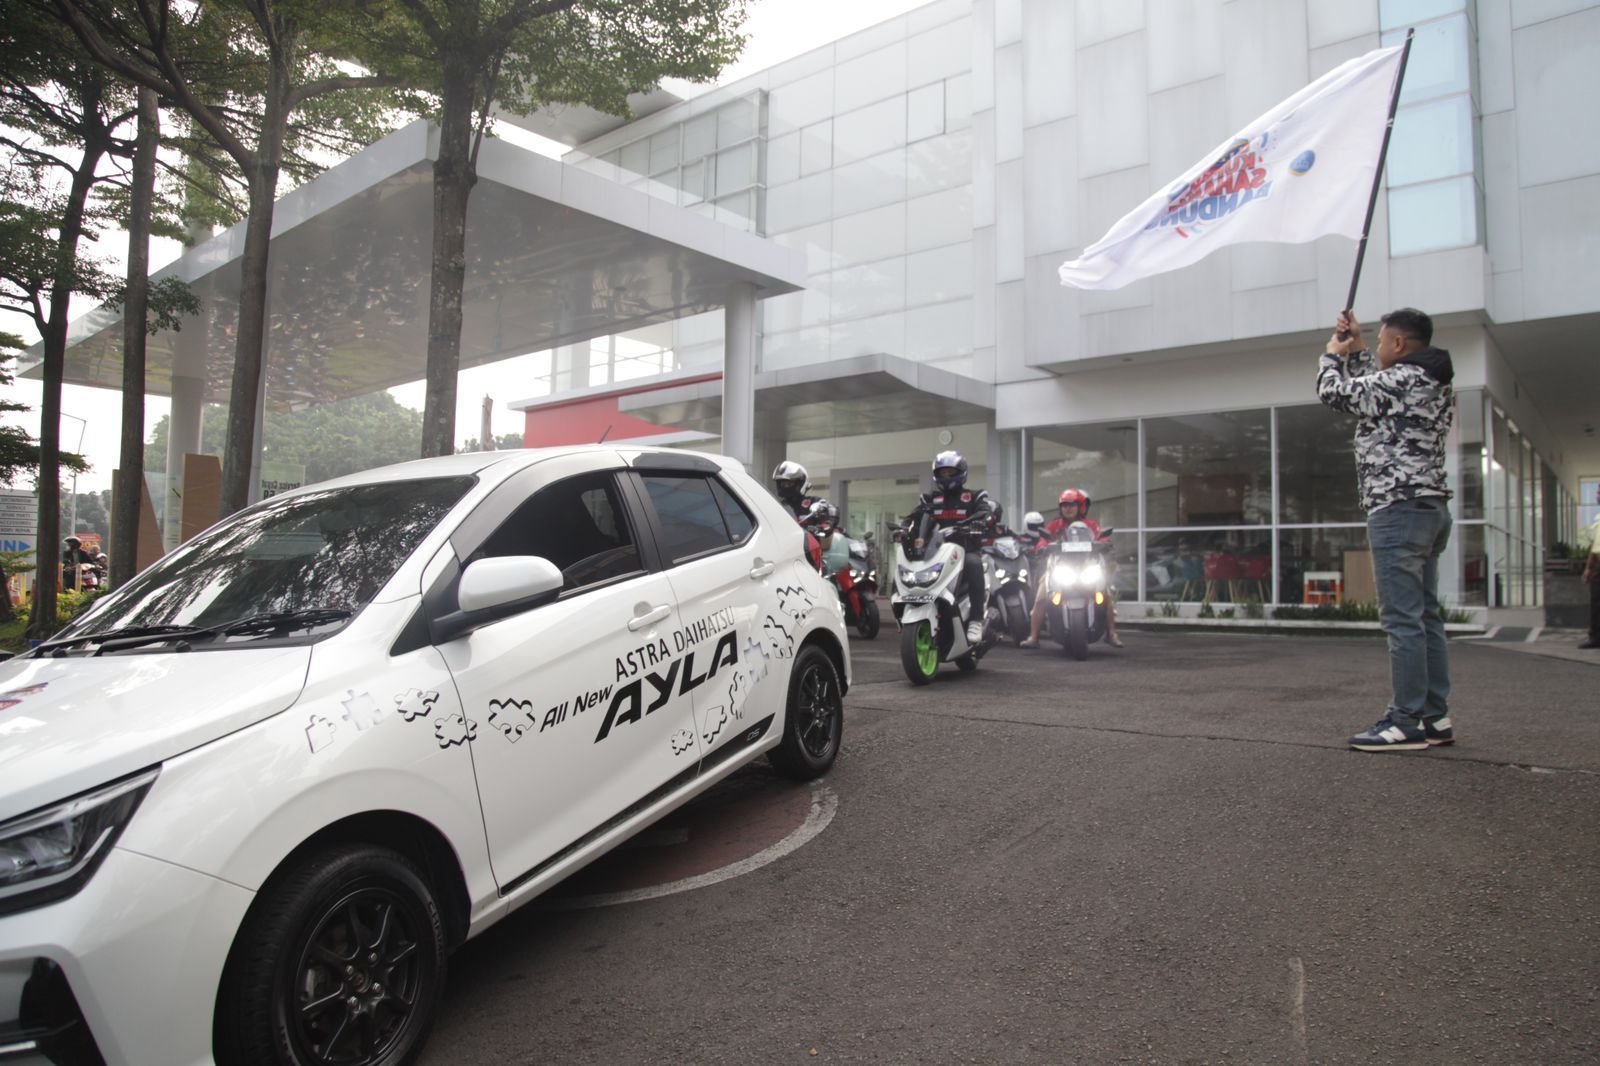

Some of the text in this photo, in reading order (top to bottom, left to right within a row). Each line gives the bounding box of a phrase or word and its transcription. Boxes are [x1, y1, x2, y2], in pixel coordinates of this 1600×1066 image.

[540, 701, 568, 732] All
[572, 684, 613, 716] New
[594, 630, 738, 744] AYLA
[616, 606, 735, 682] ASTRA DAIHATSU
